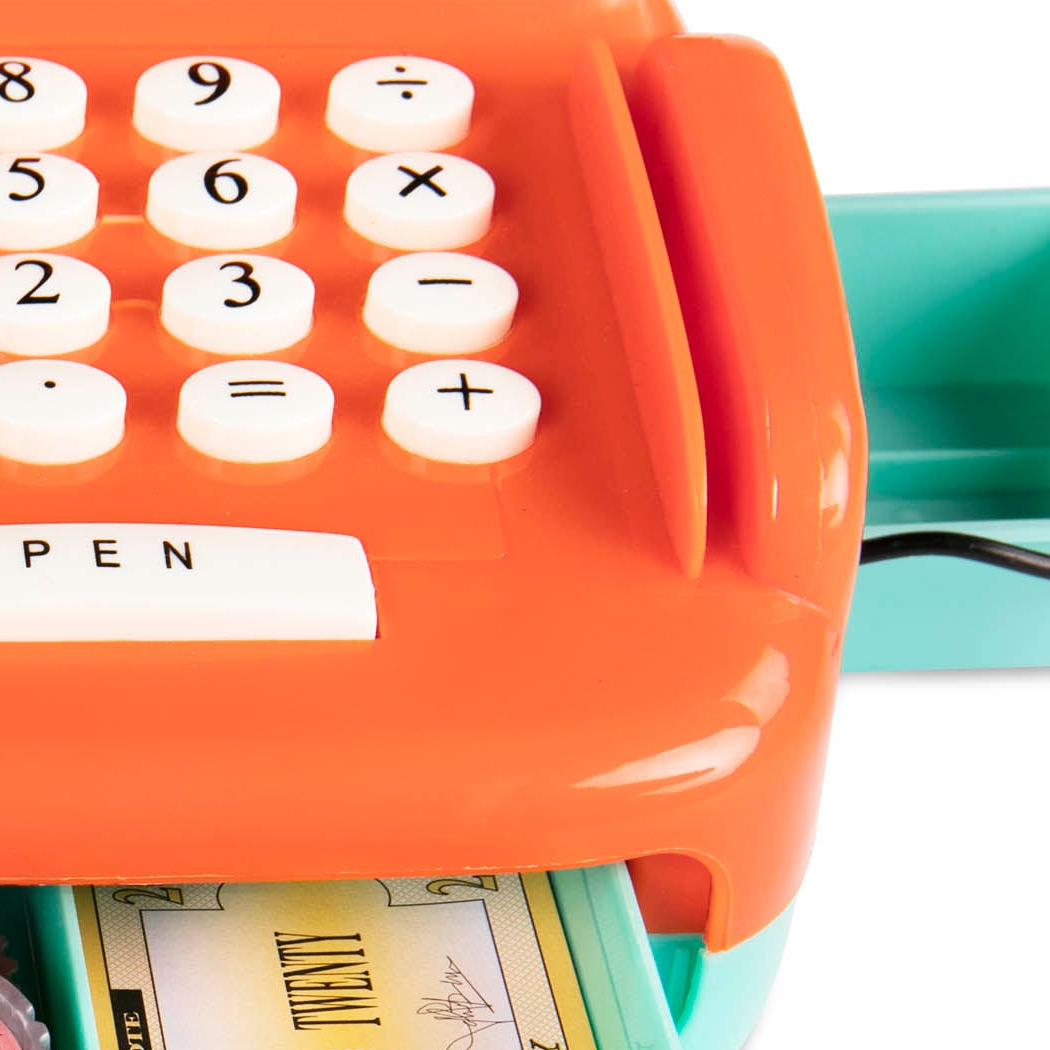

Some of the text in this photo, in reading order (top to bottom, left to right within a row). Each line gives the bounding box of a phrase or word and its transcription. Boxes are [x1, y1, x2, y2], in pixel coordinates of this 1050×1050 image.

[187, 62, 232, 106] 9
[7, 157, 46, 203] 5
[203, 159, 250, 205] 6
[14, 260, 61, 306] 2
[218, 261, 262, 309] 3
[273, 930, 382, 1031] TWENTY
